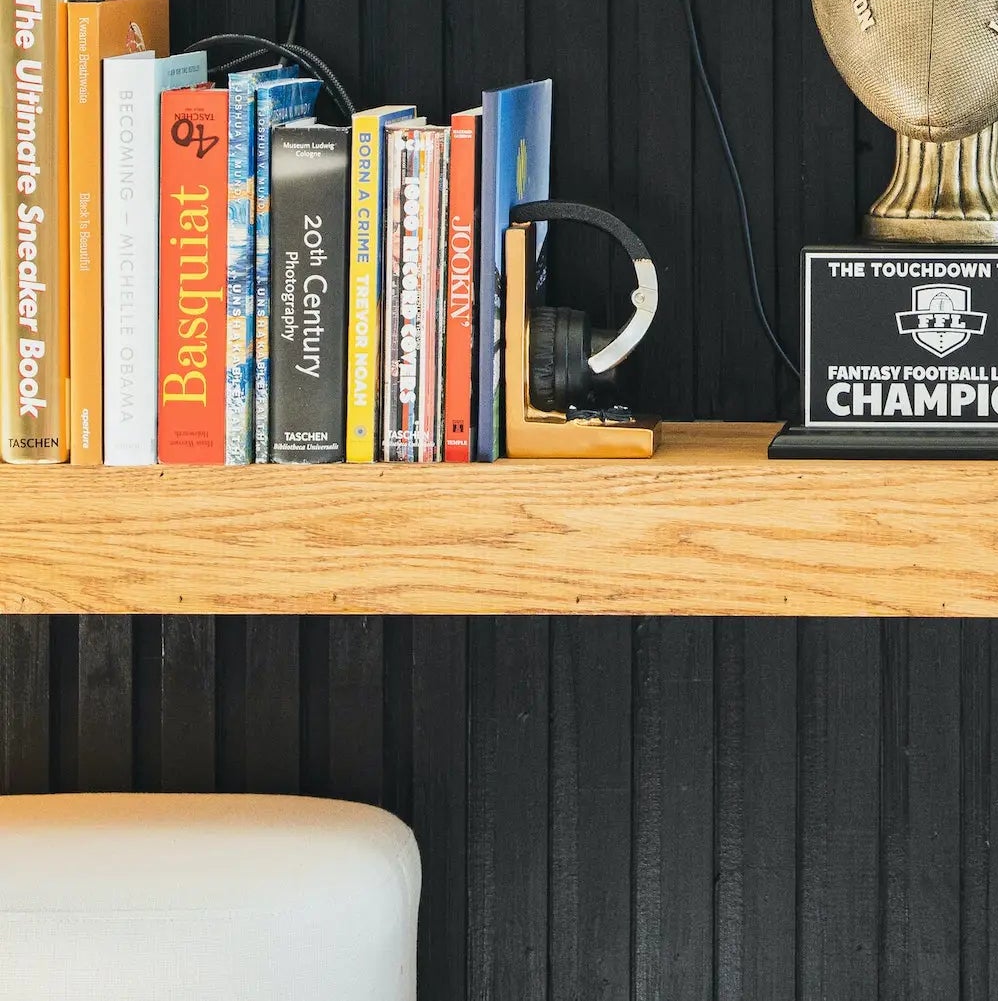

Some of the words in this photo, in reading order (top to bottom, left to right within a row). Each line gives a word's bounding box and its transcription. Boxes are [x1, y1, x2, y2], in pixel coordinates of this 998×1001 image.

[16, 59, 44, 195] Ultimate
[174, 112, 216, 121] TASCHEN
[234, 86, 242, 138] JOSHUA
[119, 89, 134, 201] BECOMING
[283, 142, 310, 150] Museum
[312, 141, 335, 151] Ludwig
[295, 150, 322, 159] Cologne
[358, 132, 371, 184] BORN
[79, 192, 90, 218] Black
[234, 161, 242, 203] MUNDY
[358, 190, 370, 201] A
[303, 214, 328, 267] 20th
[356, 206, 369, 264] CRIME
[17, 203, 46, 332] Sneaker
[119, 233, 134, 336] MICHELLE
[828, 262, 865, 278] THE
[871, 262, 991, 278] TOUCHDOWN
[162, 184, 224, 408] Basquiat
[280, 251, 298, 342] Photography
[354, 274, 369, 346] TREVOR
[917, 313, 966, 329] FFL
[295, 274, 328, 379] Century
[18, 337, 47, 419] Book
[119, 346, 134, 424] OBAMA
[353, 350, 368, 407] NOAH
[828, 366, 900, 381] FANTASY
[903, 366, 989, 381] FOOTBALL
[8, 438, 59, 449] TASCHEN
[284, 431, 328, 441] TASCHEN
